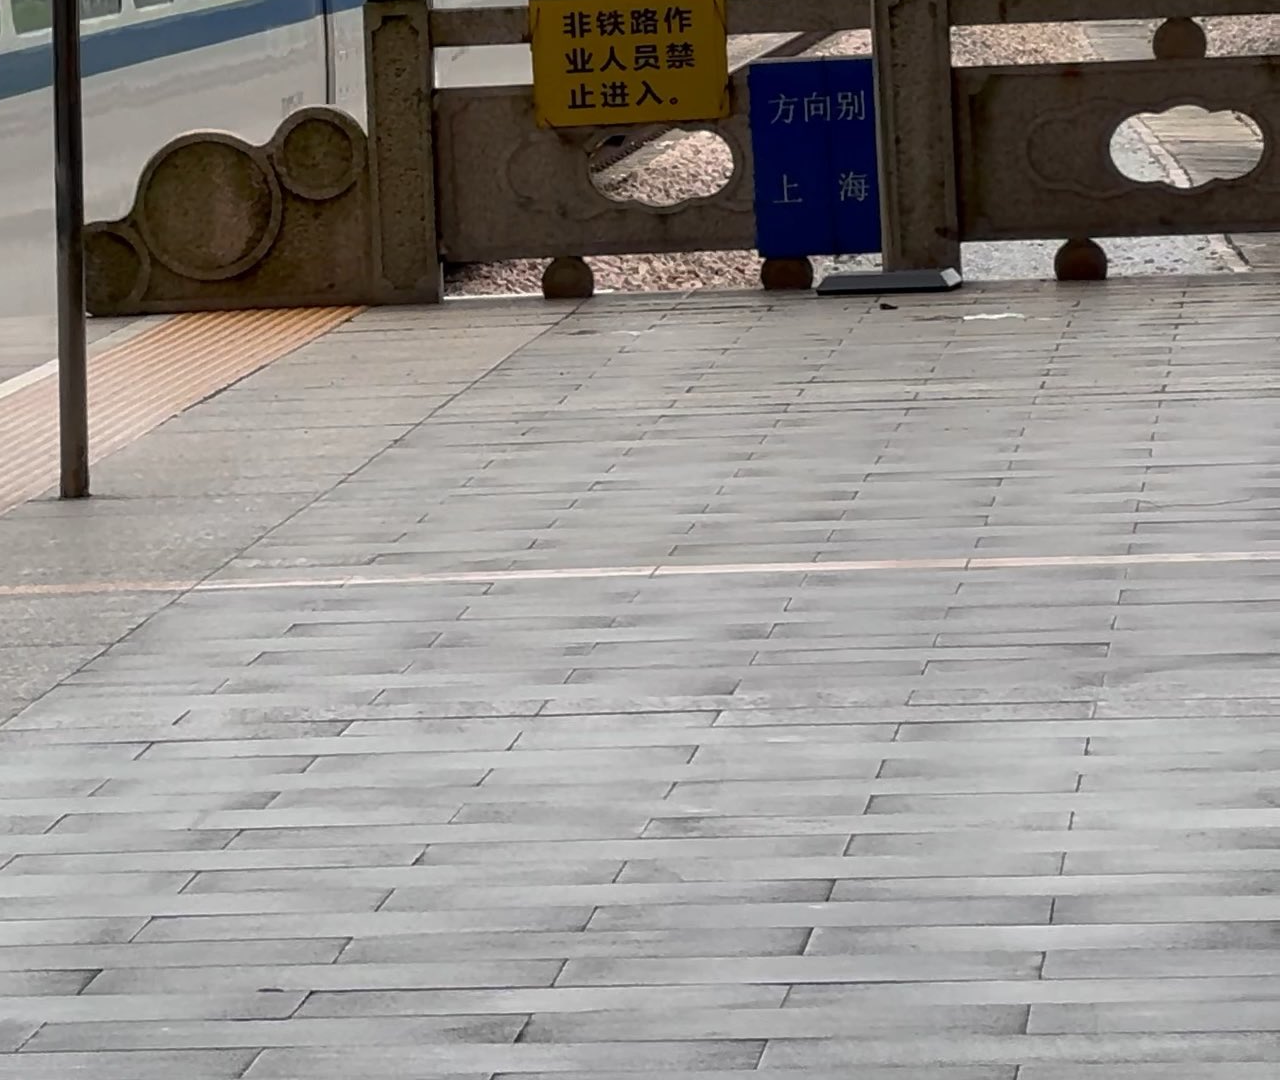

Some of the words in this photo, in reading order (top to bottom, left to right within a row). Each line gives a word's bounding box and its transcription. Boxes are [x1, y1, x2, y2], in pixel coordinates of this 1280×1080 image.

[562, 6, 693, 39] 非铁路作
[565, 42, 696, 74] 业人员禁
[767, 89, 866, 125] 方向别
